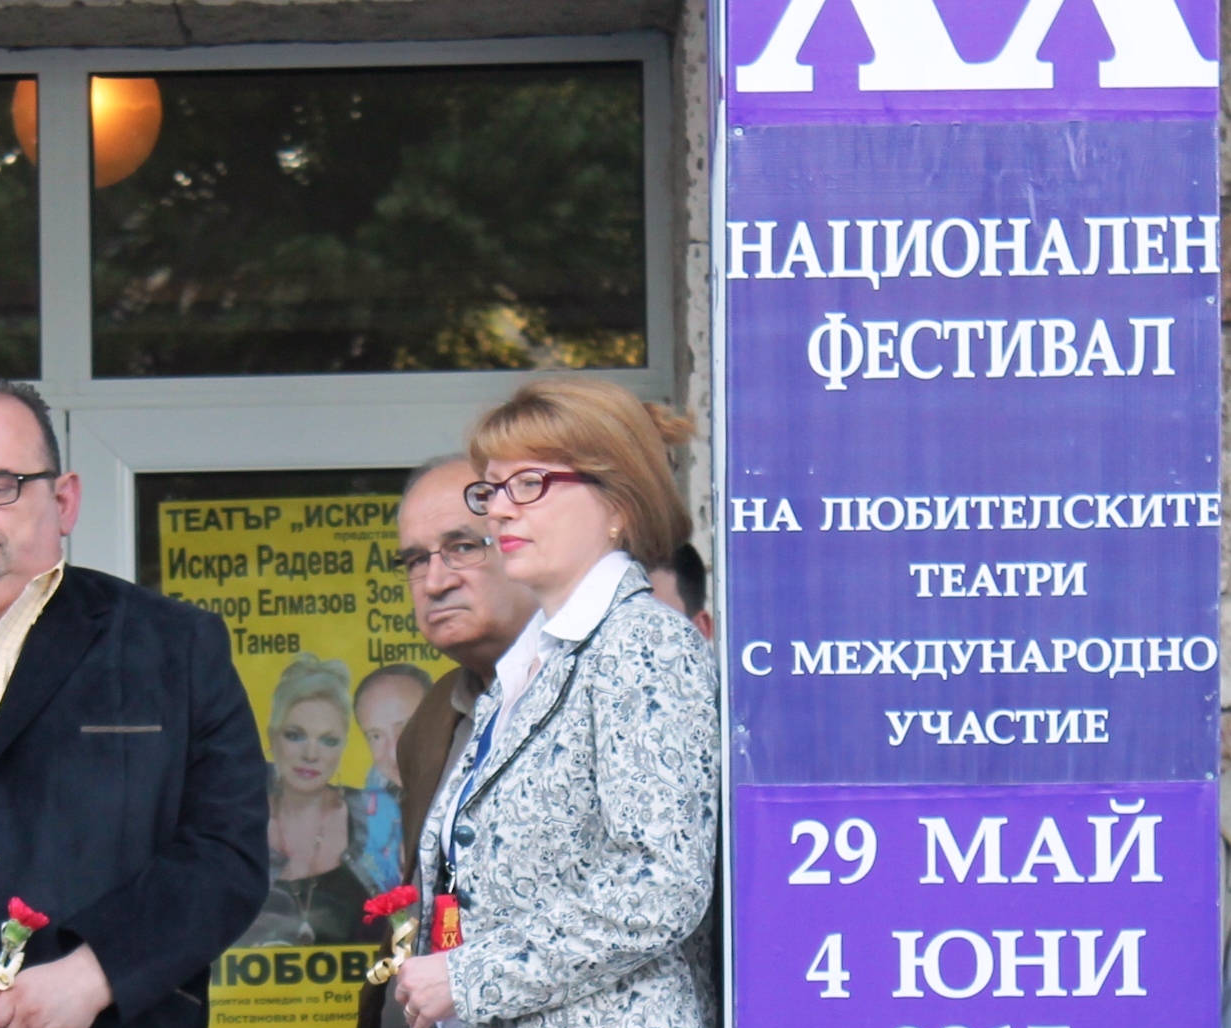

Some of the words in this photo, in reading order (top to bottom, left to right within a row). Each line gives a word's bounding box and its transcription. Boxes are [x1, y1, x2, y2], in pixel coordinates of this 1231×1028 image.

[726, 215, 1220, 290] НАЦИОНАЛЕН
[807, 312, 1175, 390] ФЕСТИВАЛ
[166, 505, 281, 533] ТЕАТЪР
[730, 498, 802, 532] НА
[820, 493, 1221, 531] ЛЮБИТЕЛСКИТЕ
[168, 547, 247, 587] Искра
[257, 545, 354, 583] Радева
[910, 562, 1087, 597] ТЕАТРИ
[258, 589, 357, 616] Елмазов
[367, 579, 404, 604] Зоя
[233, 628, 300, 655] Танев
[742, 642, 772, 676] С
[791, 636, 1218, 680] МЕЖДУНАРОДНО
[885, 709, 1109, 745] УЧАСТИЕ
[788, 818, 877, 886] 29
[918, 798, 1163, 885] МАЙ
[806, 933, 850, 998] 4
[892, 929, 1147, 999] ЮНИ
[324, 990, 353, 1004] Рей
[216, 1013, 296, 1024] Постановка
